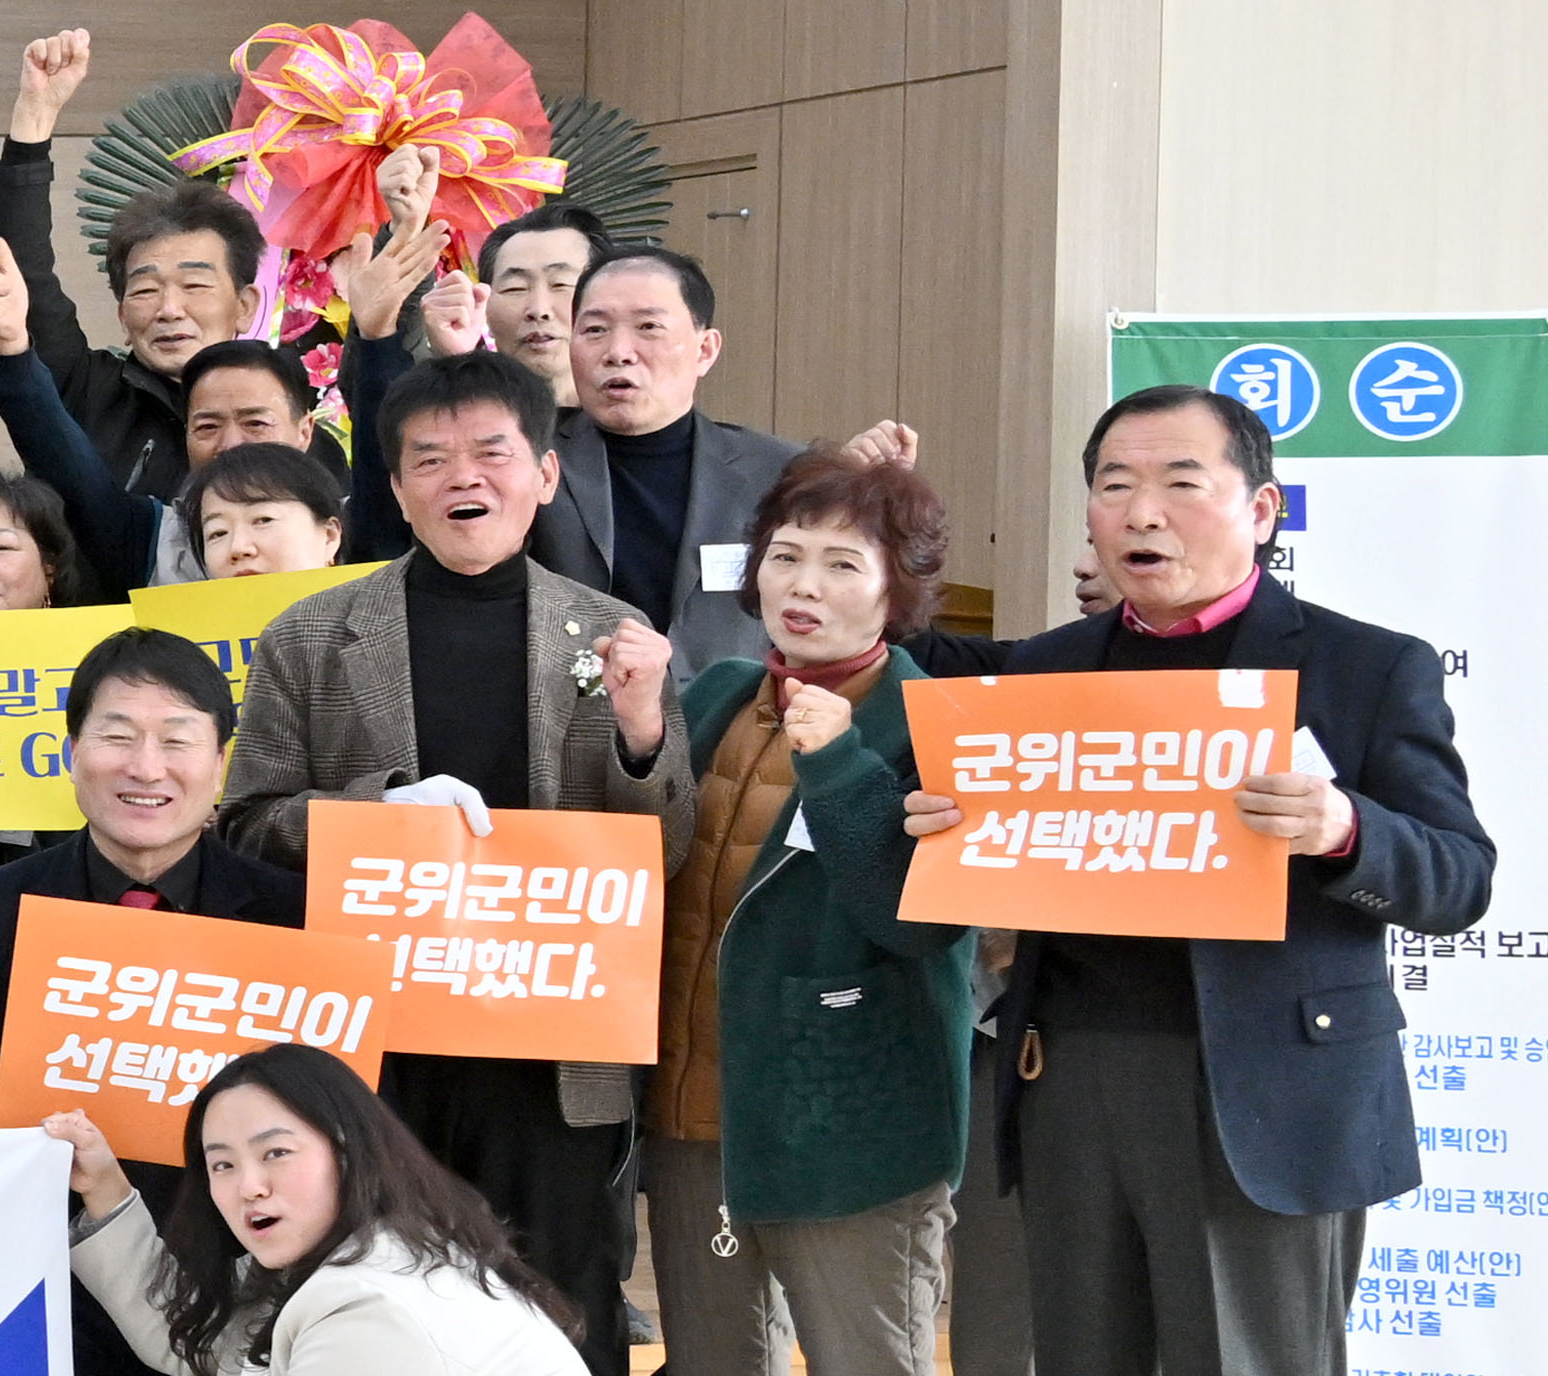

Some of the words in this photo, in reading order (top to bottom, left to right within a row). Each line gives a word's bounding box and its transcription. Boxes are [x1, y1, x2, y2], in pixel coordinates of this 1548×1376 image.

[951, 727, 1274, 793] 군위군민이
[959, 809, 1229, 874] 선택했다.
[341, 857, 650, 927] 군위군민이
[43, 956, 373, 1054] 군위군민이
[1413, 1034, 1493, 1059] 감사보고
[1500, 1036, 1519, 1061] 및
[1414, 1065, 1467, 1091] 선출
[1410, 1187, 1477, 1214] 가입금
[1368, 1247, 1419, 1273] 세출
[1445, 1280, 1497, 1309] 선출
[1390, 1310, 1442, 1337] 선출
